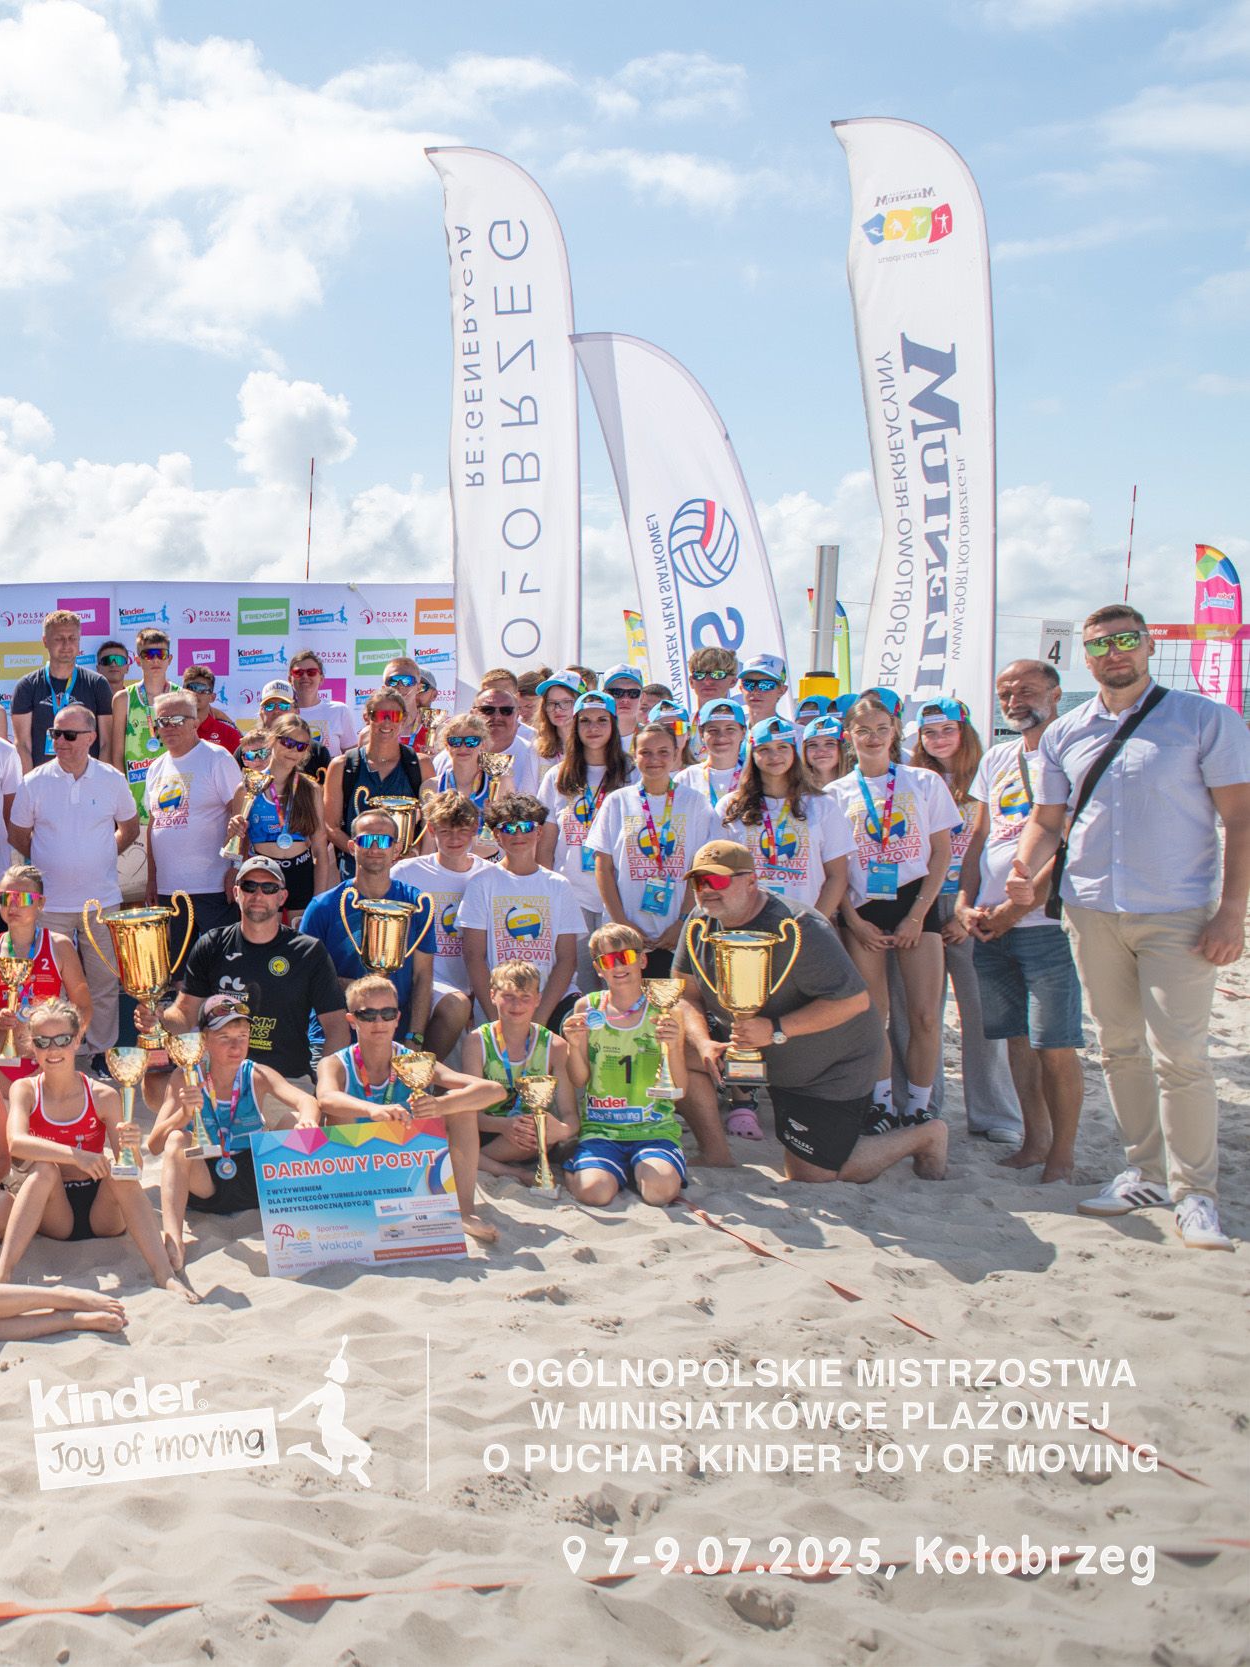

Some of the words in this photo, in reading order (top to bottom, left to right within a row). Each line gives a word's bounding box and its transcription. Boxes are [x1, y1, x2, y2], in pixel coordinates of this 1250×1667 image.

[118, 607, 144, 616] Kinder
[244, 611, 284, 620] FRIENDSHIP
[298, 608, 324, 617] Kinder
[237, 648, 263, 657] Kinder
[361, 653, 399, 661] FRIENDSHIP
[414, 647, 439, 656] Kinder
[1048, 640, 1061, 665] 4
[41, 957, 51, 970] 2
[618, 1055, 632, 1084] 1
[587, 1096, 627, 1108] Kinder
[590, 1111, 604, 1121] Joy
[613, 1111, 641, 1122] moving
[89, 1116, 97, 1129] 2
[262, 1154, 369, 1181] DARMOWY
[372, 1149, 437, 1171] POBYT
[272, 1184, 323, 1195] WYŻYWIENIEM
[330, 1191, 363, 1199] TURNIEJU
[383, 1186, 412, 1195] TRENERA
[318, 1240, 364, 1251] Wakacje
